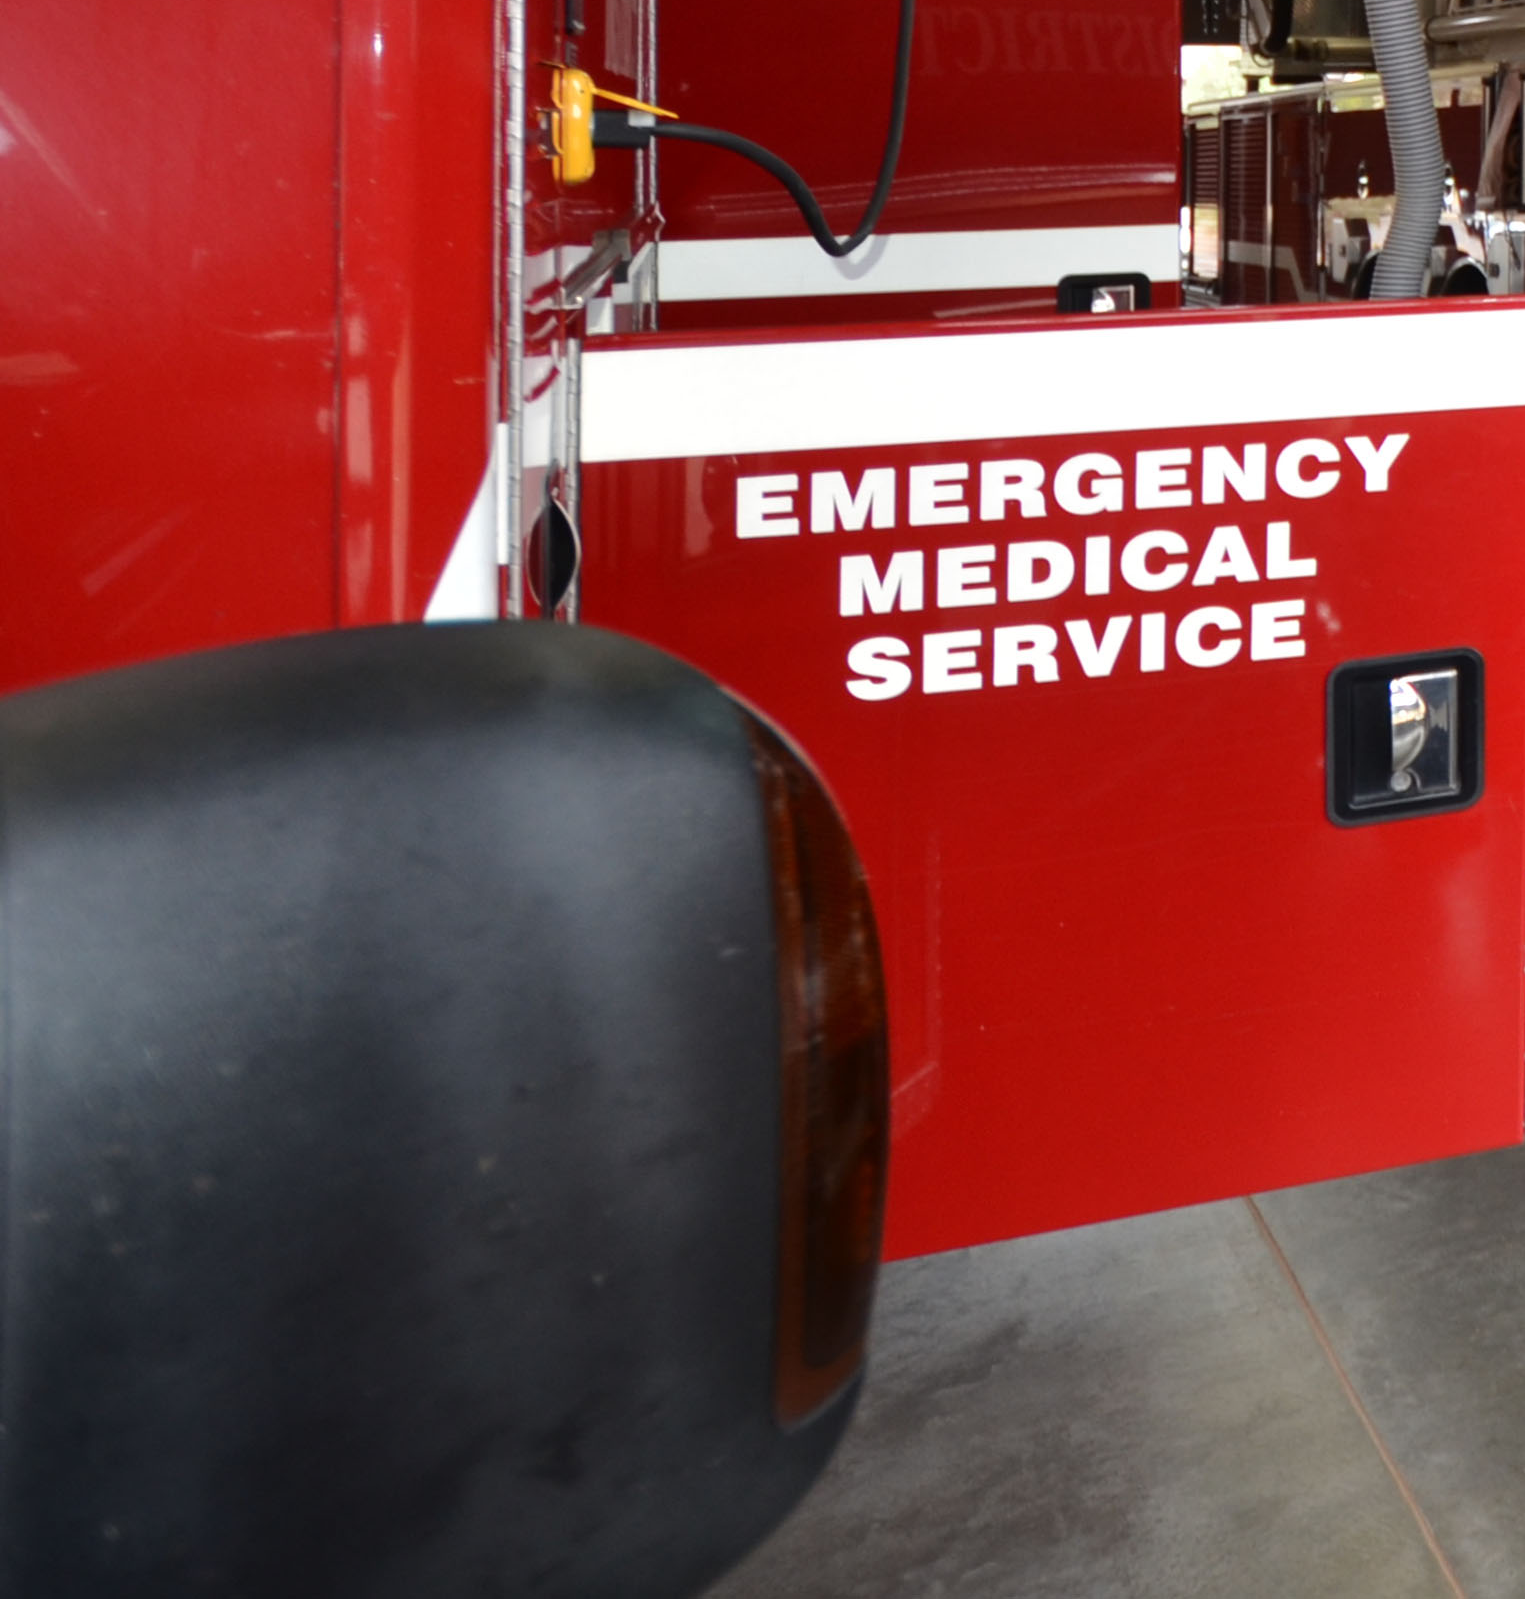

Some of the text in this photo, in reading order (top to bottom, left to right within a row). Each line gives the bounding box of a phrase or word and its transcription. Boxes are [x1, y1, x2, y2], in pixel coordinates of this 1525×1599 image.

[735, 433, 1411, 539] EMERGENCY
[839, 521, 1317, 617] MEDICAL
[845, 599, 1306, 702] SERVICE
